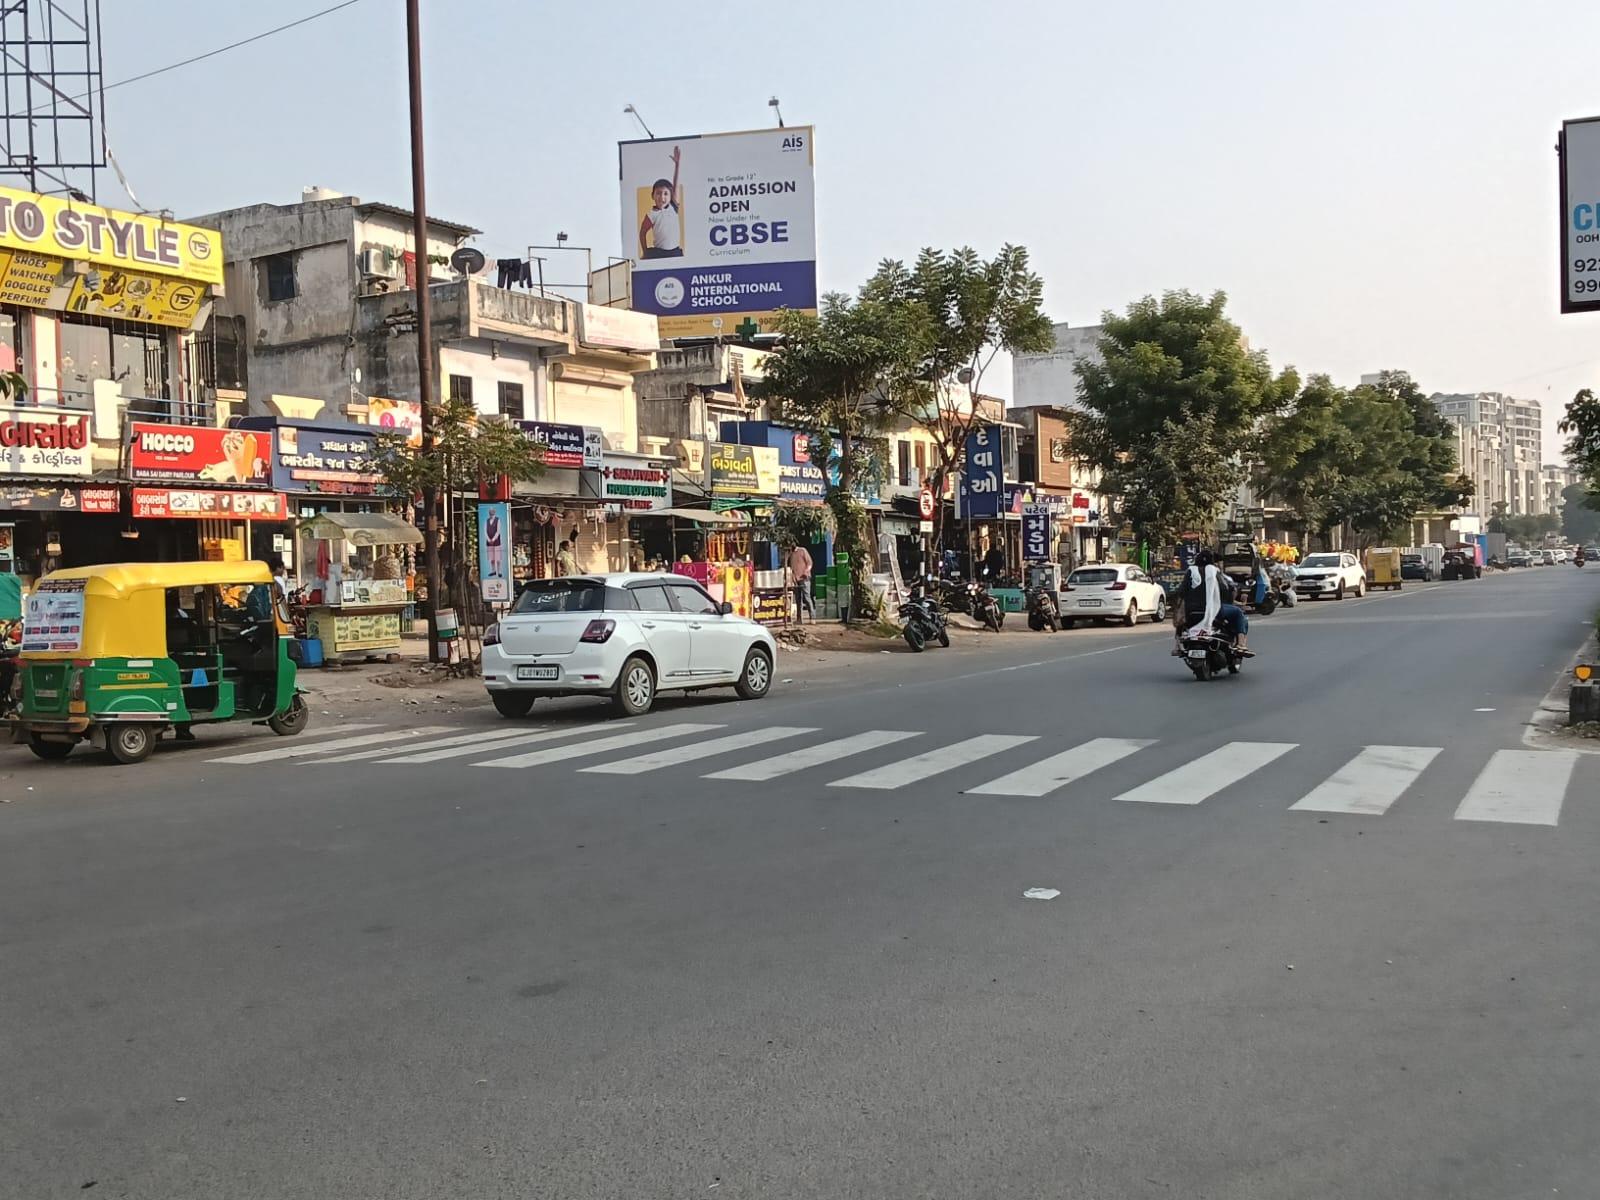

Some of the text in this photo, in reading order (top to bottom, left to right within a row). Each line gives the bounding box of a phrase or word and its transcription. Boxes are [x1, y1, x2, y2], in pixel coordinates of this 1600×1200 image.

[709, 180, 796, 198] ADMISSION
[709, 200, 749, 214] OPEN
[58, 209, 180, 264] STYLE
[710, 221, 788, 246] CBSE
[709, 248, 750, 256] Curriculum
[15, 256, 47, 268] SHOES
[10, 268, 55, 282] WATCHES
[691, 273, 732, 285] ANKUR
[5, 280, 52, 294] GOGGLES
[691, 282, 782, 296] INTERNATIONAL
[0, 292, 48, 306] PERFUME
[692, 296, 738, 307] SCHOOL
[142, 432, 194, 453] HOCCO
[282, 452, 322, 468] ભારતીય
[326, 458, 344, 469] જન
[712, 456, 752, 472] ભગવતી
[607, 484, 667, 497] HOMEOPATHIC
[780, 481, 823, 495] PHARMACY
[1025, 504, 1047, 514] પટેલ
